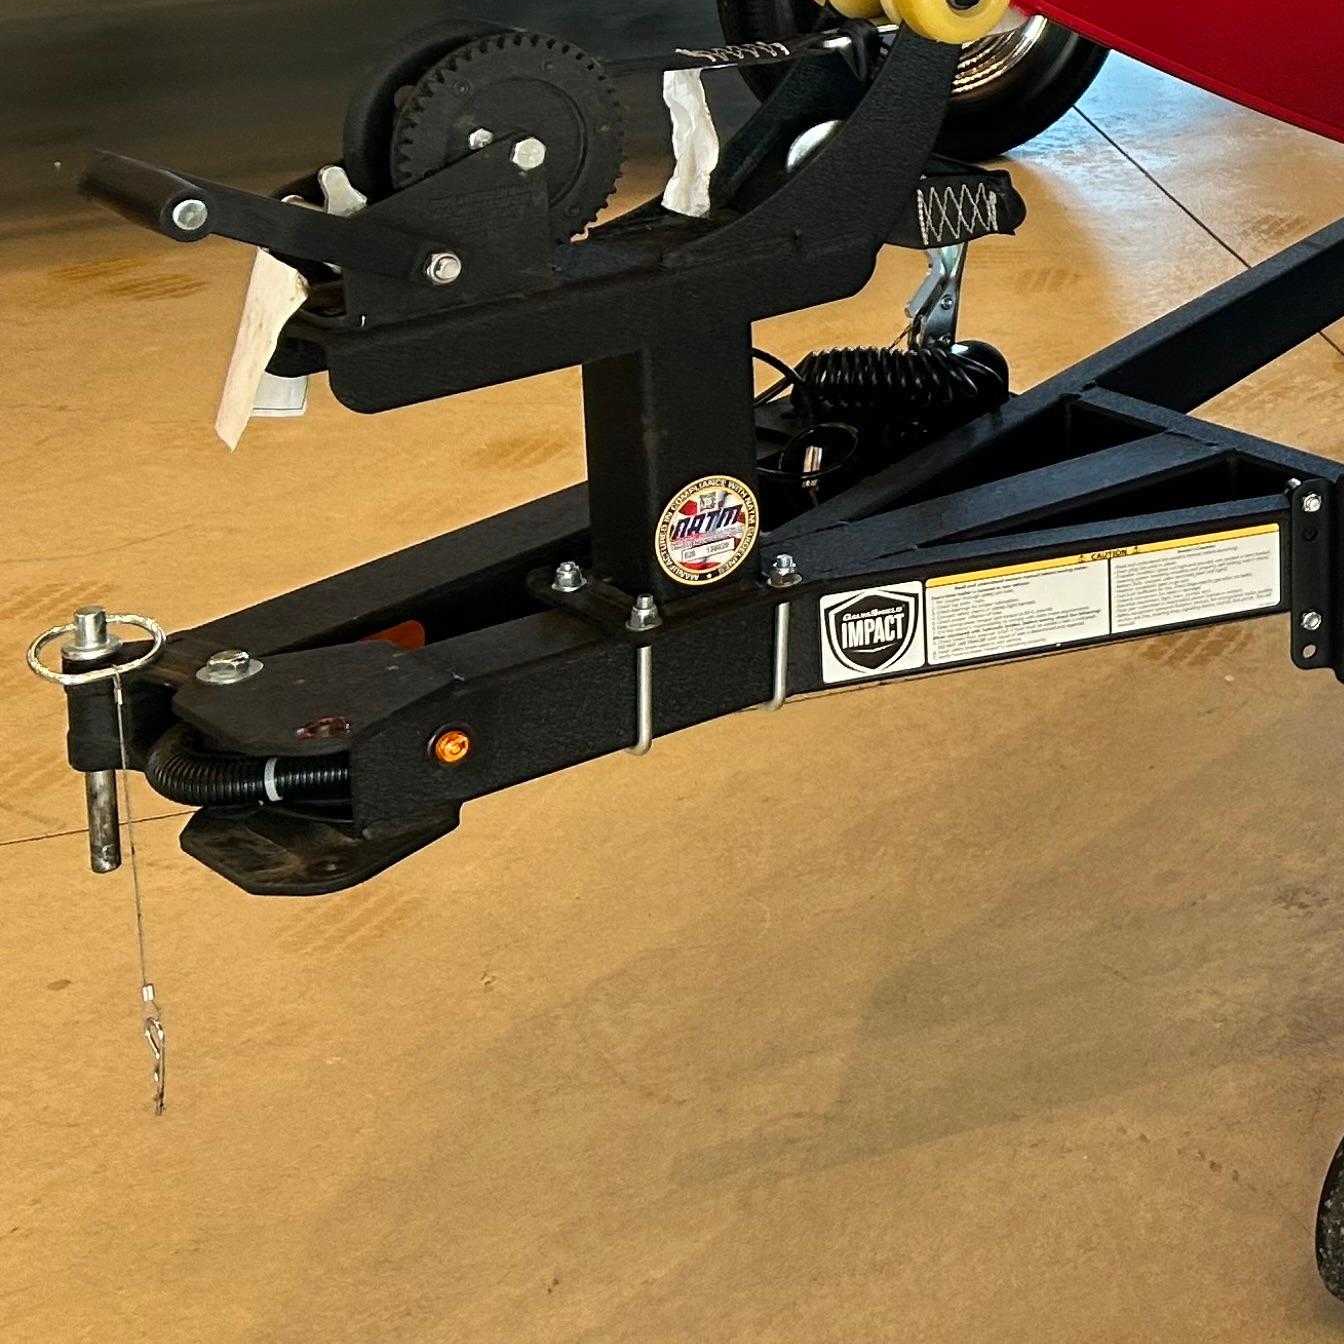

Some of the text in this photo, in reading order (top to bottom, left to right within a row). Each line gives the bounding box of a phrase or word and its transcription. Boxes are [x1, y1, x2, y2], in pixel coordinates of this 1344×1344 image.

[672, 504, 743, 541] NATM
[1091, 549, 1127, 560] CAUTION
[841, 613, 905, 649] IMPACT
